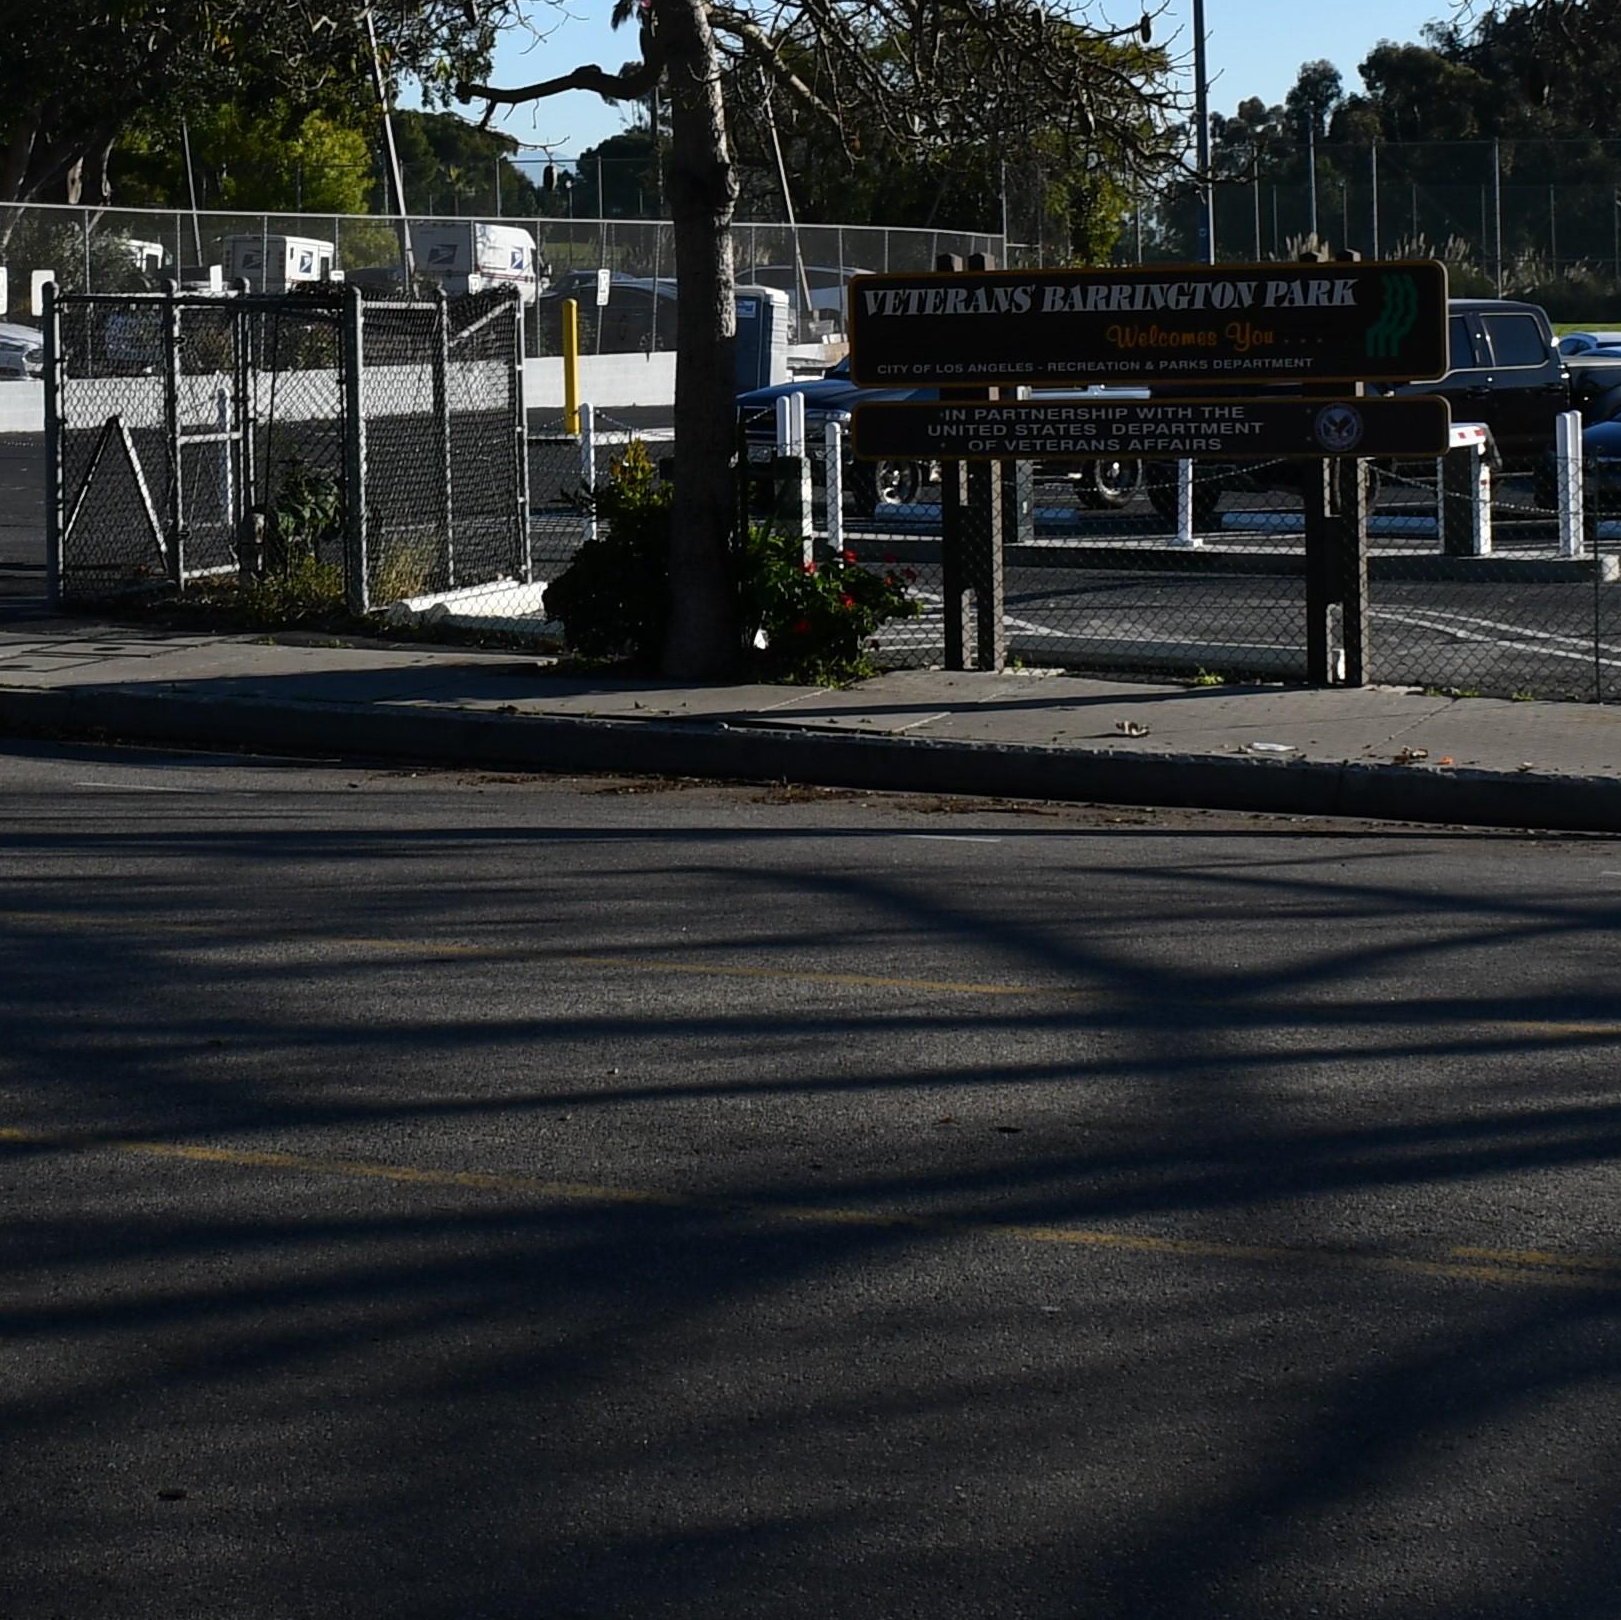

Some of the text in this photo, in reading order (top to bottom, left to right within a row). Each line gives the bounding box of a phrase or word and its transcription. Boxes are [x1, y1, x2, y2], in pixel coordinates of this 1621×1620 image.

[1041, 280, 1260, 313] BARRINGTON
[1264, 278, 1359, 308] PARK
[1106, 324, 1218, 349] Welcomes
[1224, 322, 1276, 352] You
[877, 364, 909, 375] CITY
[912, 363, 931, 374] OF
[936, 363, 963, 374] LOS
[967, 362, 1034, 373] ANGELES
[1047, 360, 1140, 372] RECREATION
[1145, 360, 1155, 370] &
[1159, 359, 1208, 370] PARKS
[1213, 357, 1314, 369] DEPARTMENT
[944, 406, 1245, 421] IN PARTNERSHIP WITH THE
[927, 422, 1264, 437] UNITED STATES DEPARTMENT
[968, 438, 1223, 452] OF VETERANS AFFAIRS
